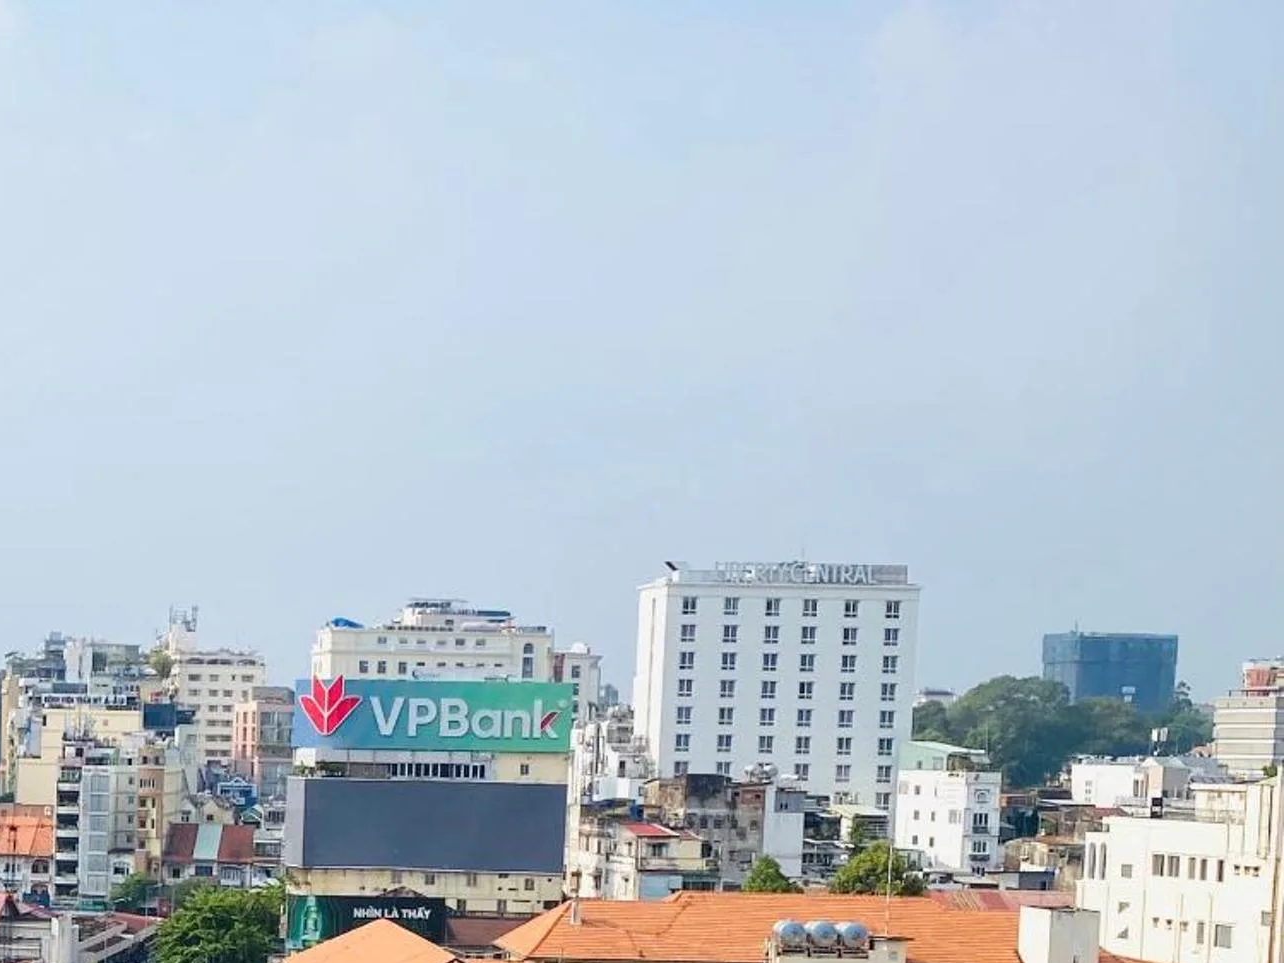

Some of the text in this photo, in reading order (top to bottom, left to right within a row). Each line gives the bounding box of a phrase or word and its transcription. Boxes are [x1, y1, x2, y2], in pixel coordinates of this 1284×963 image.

[369, 695, 560, 741] VPBank
[353, 905, 382, 918] NHÌN
[384, 905, 400, 918] LÀ
